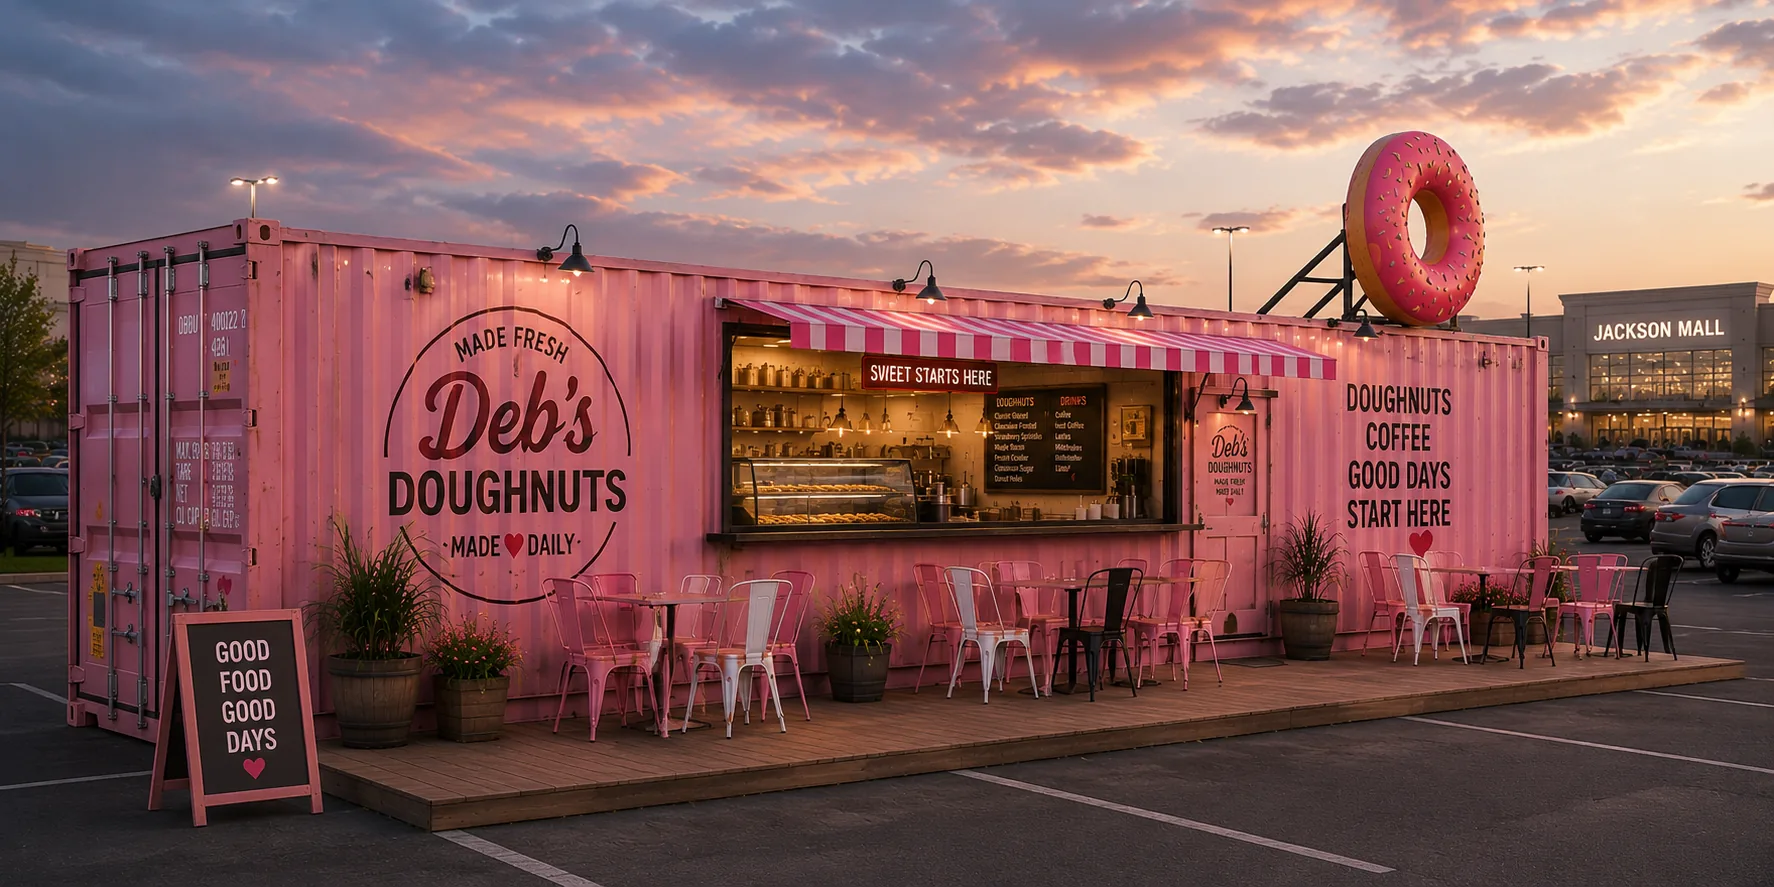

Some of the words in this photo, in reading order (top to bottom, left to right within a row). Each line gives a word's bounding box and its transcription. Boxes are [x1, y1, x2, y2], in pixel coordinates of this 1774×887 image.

[1593, 321, 1671, 341] JACKSON
[1678, 319, 1725, 337] MALL
[454, 326, 507, 363] MADE
[513, 326, 570, 364] FRESH
[915, 367, 960, 385] STARTS
[963, 368, 992, 386] HERE
[1347, 383, 1451, 415] DOUGHNUTS
[418, 370, 598, 461] Deb's
[1211, 433, 1249, 458] Deb's
[1366, 422, 1431, 451] COFFEE
[1208, 461, 1253, 474] DOUGHNUTS
[1348, 460, 1400, 489] GOOD
[1406, 461, 1451, 489] DAYS
[388, 469, 627, 516] DOUGHNUTS
[1347, 499, 1402, 528] START
[1407, 499, 1451, 527] HERE
[451, 535, 500, 558] MADE
[527, 533, 575, 556] DAILY
[215, 639, 270, 663] GOOD
[220, 669, 272, 693] FOOD
[222, 698, 276, 723] GOOD
[226, 727, 277, 753] DAYS
